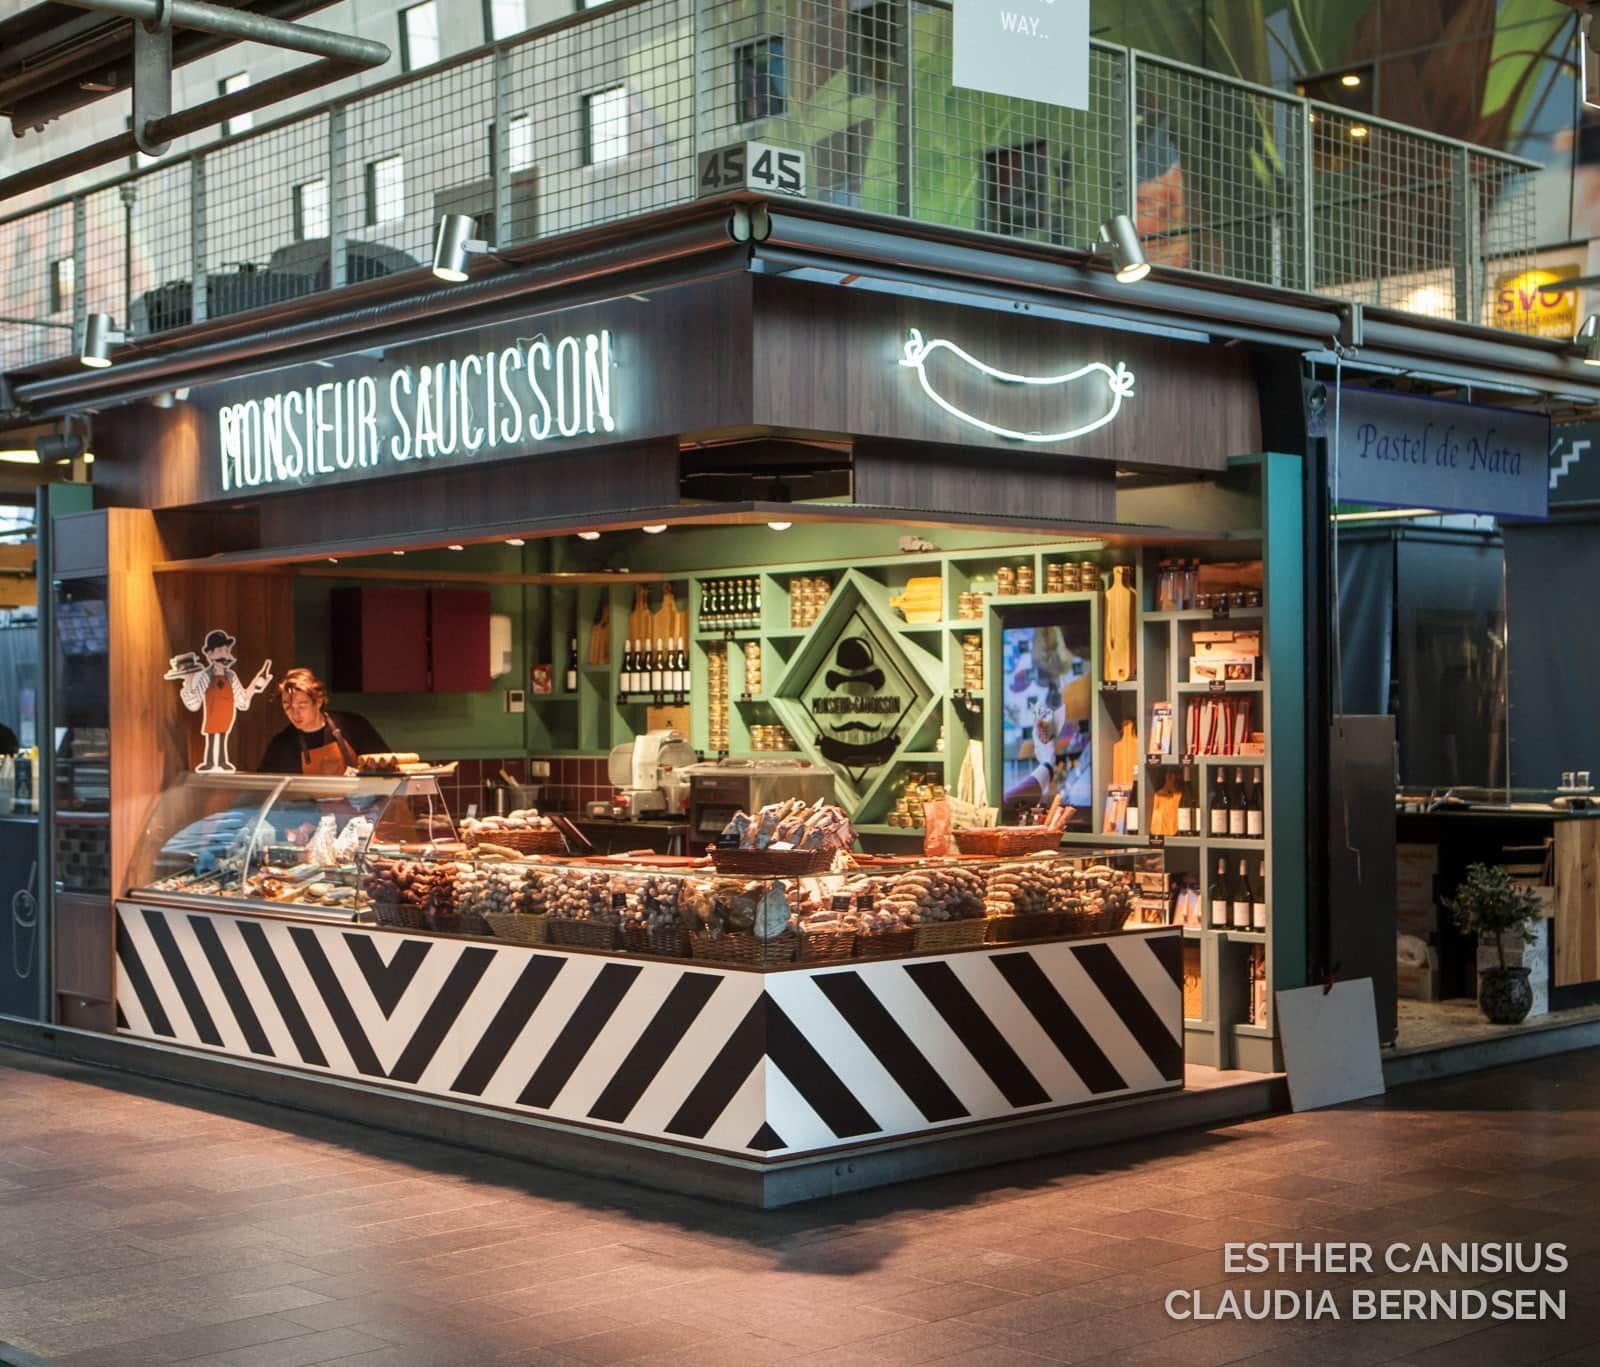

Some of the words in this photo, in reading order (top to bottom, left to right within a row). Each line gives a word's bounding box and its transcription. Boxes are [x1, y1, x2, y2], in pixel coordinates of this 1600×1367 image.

[701, 147, 744, 188] 45
[751, 148, 801, 190] 45
[218, 376, 379, 491] MONSIEUR
[389, 329, 615, 461] SAUCISSON
[1357, 421, 1434, 465] Pastel
[1435, 425, 1459, 468] de
[1467, 427, 1521, 476] Nata
